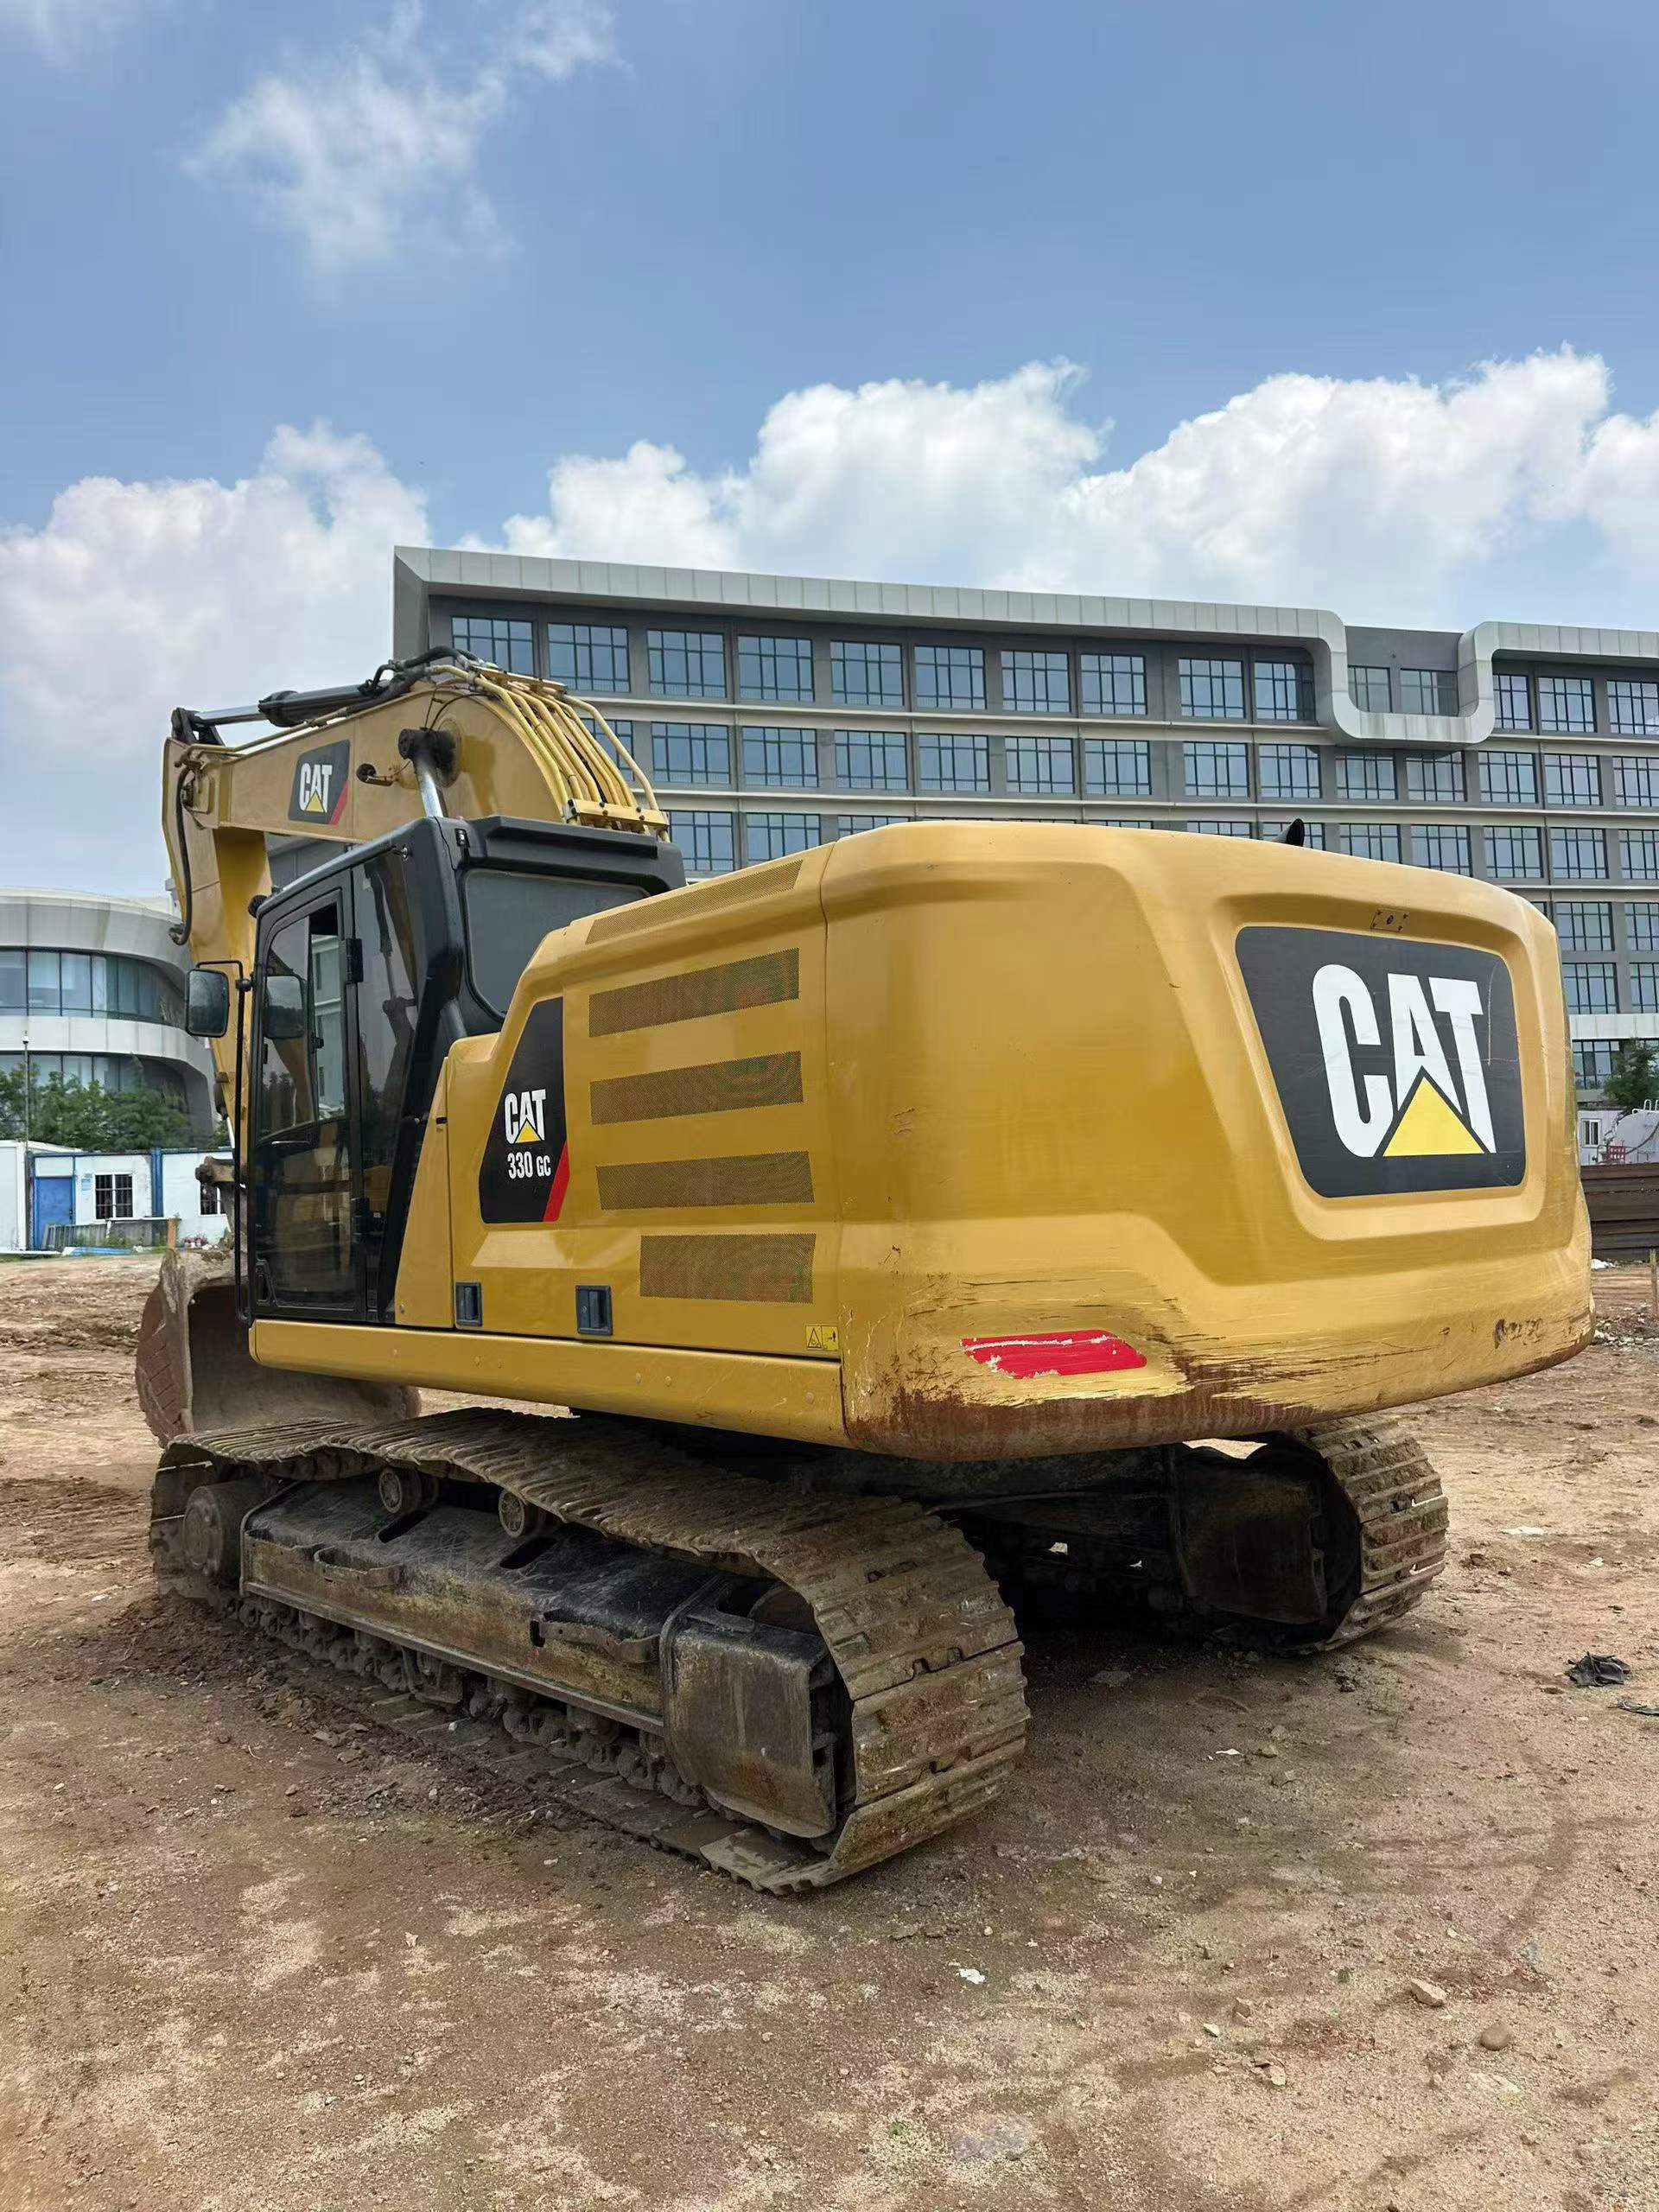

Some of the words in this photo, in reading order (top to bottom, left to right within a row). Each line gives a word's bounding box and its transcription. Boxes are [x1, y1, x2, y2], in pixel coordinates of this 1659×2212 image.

[299, 763, 333, 813] CAT
[1312, 963, 1497, 1158] CAT
[505, 1089, 546, 1144] CAT
[507, 1151, 533, 1179] 330
[536, 1155, 551, 1177] GC
